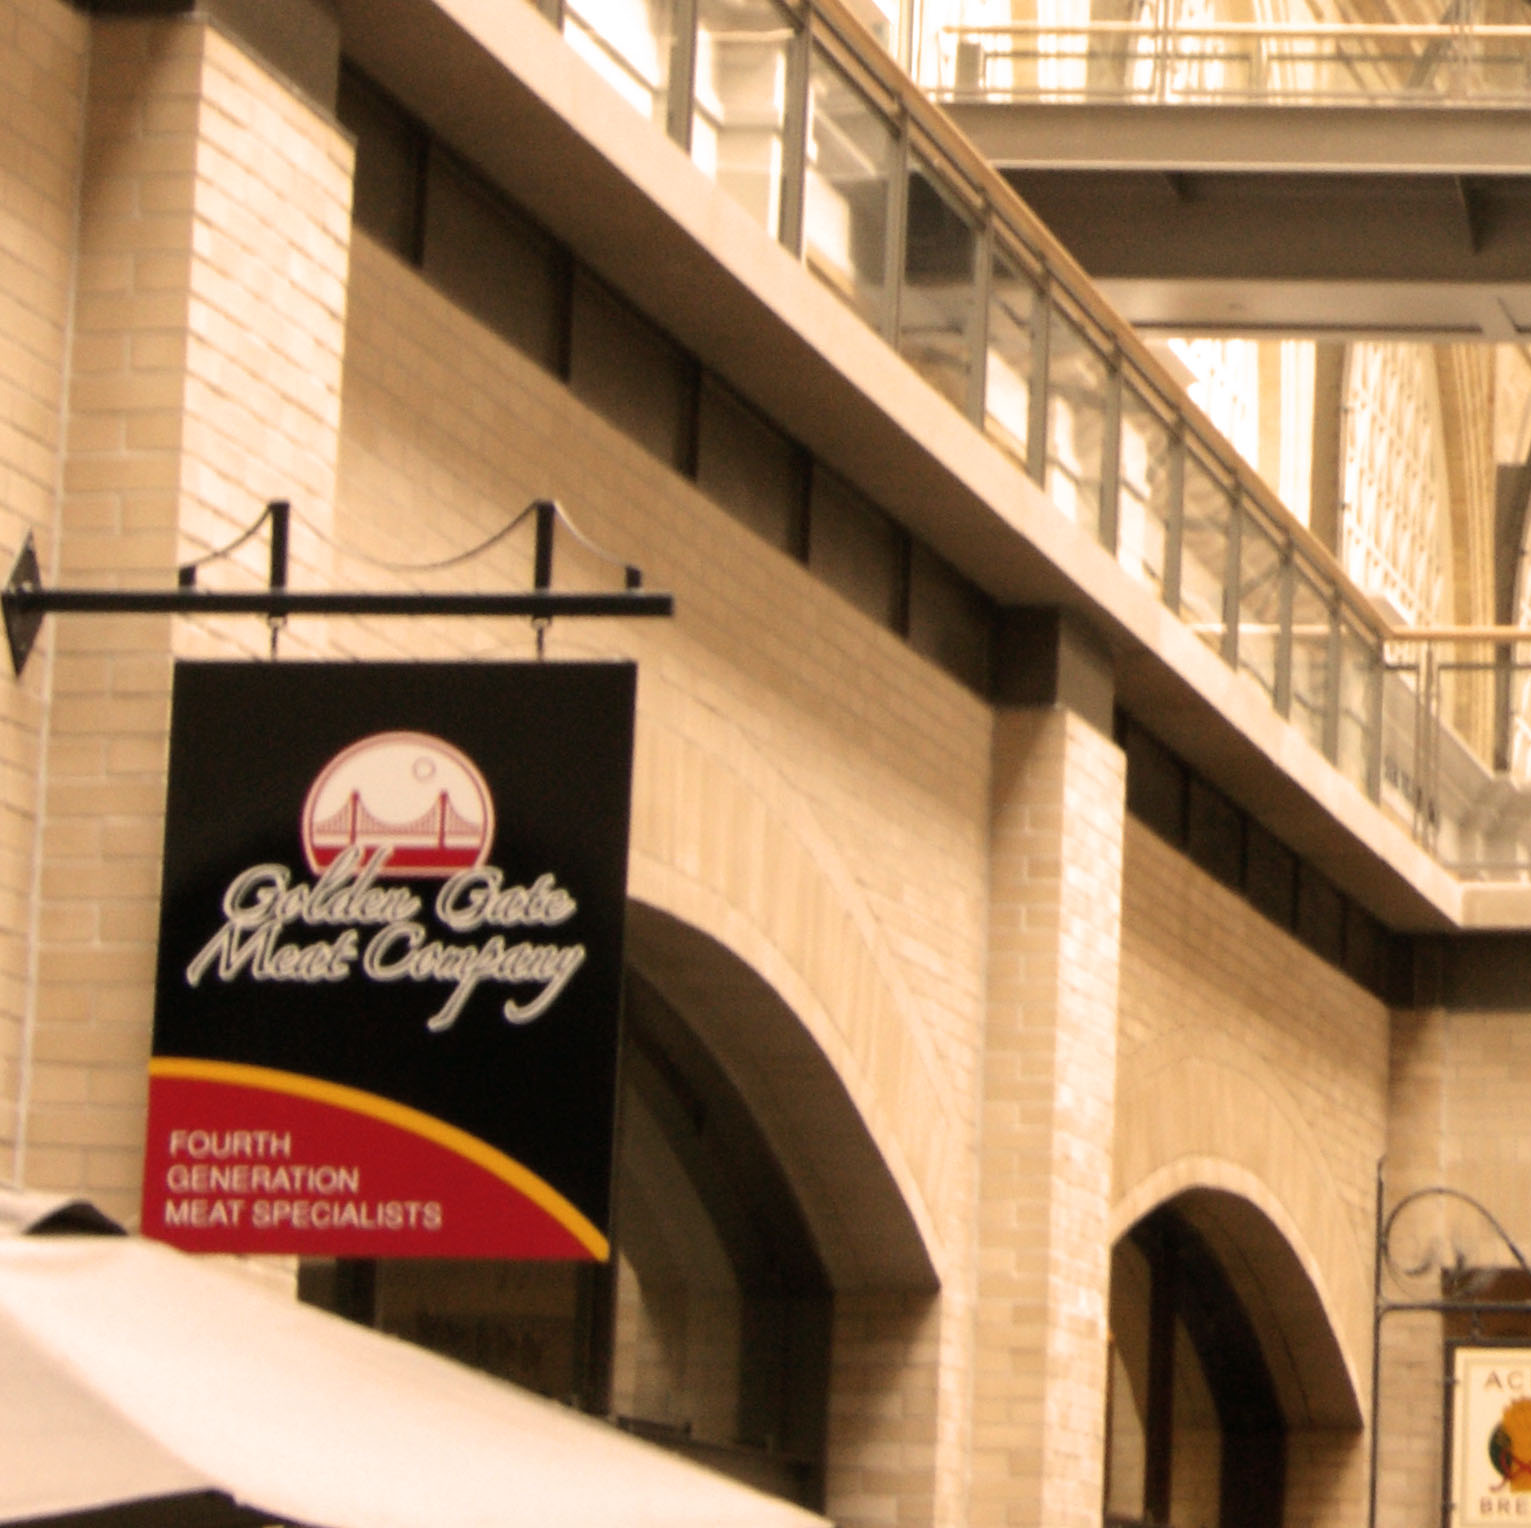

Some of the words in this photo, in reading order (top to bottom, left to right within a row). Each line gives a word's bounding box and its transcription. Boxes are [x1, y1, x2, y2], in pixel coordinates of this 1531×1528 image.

[223, 844, 421, 930] Golden
[436, 866, 578, 932] Gate
[187, 920, 359, 987] Meat
[363, 921, 587, 1032] Company
[169, 1129, 292, 1159] FOURTH
[166, 1164, 360, 1194] GENERATION
[164, 1199, 245, 1228] MEAT
[252, 1200, 443, 1230] SPECIALISTS
